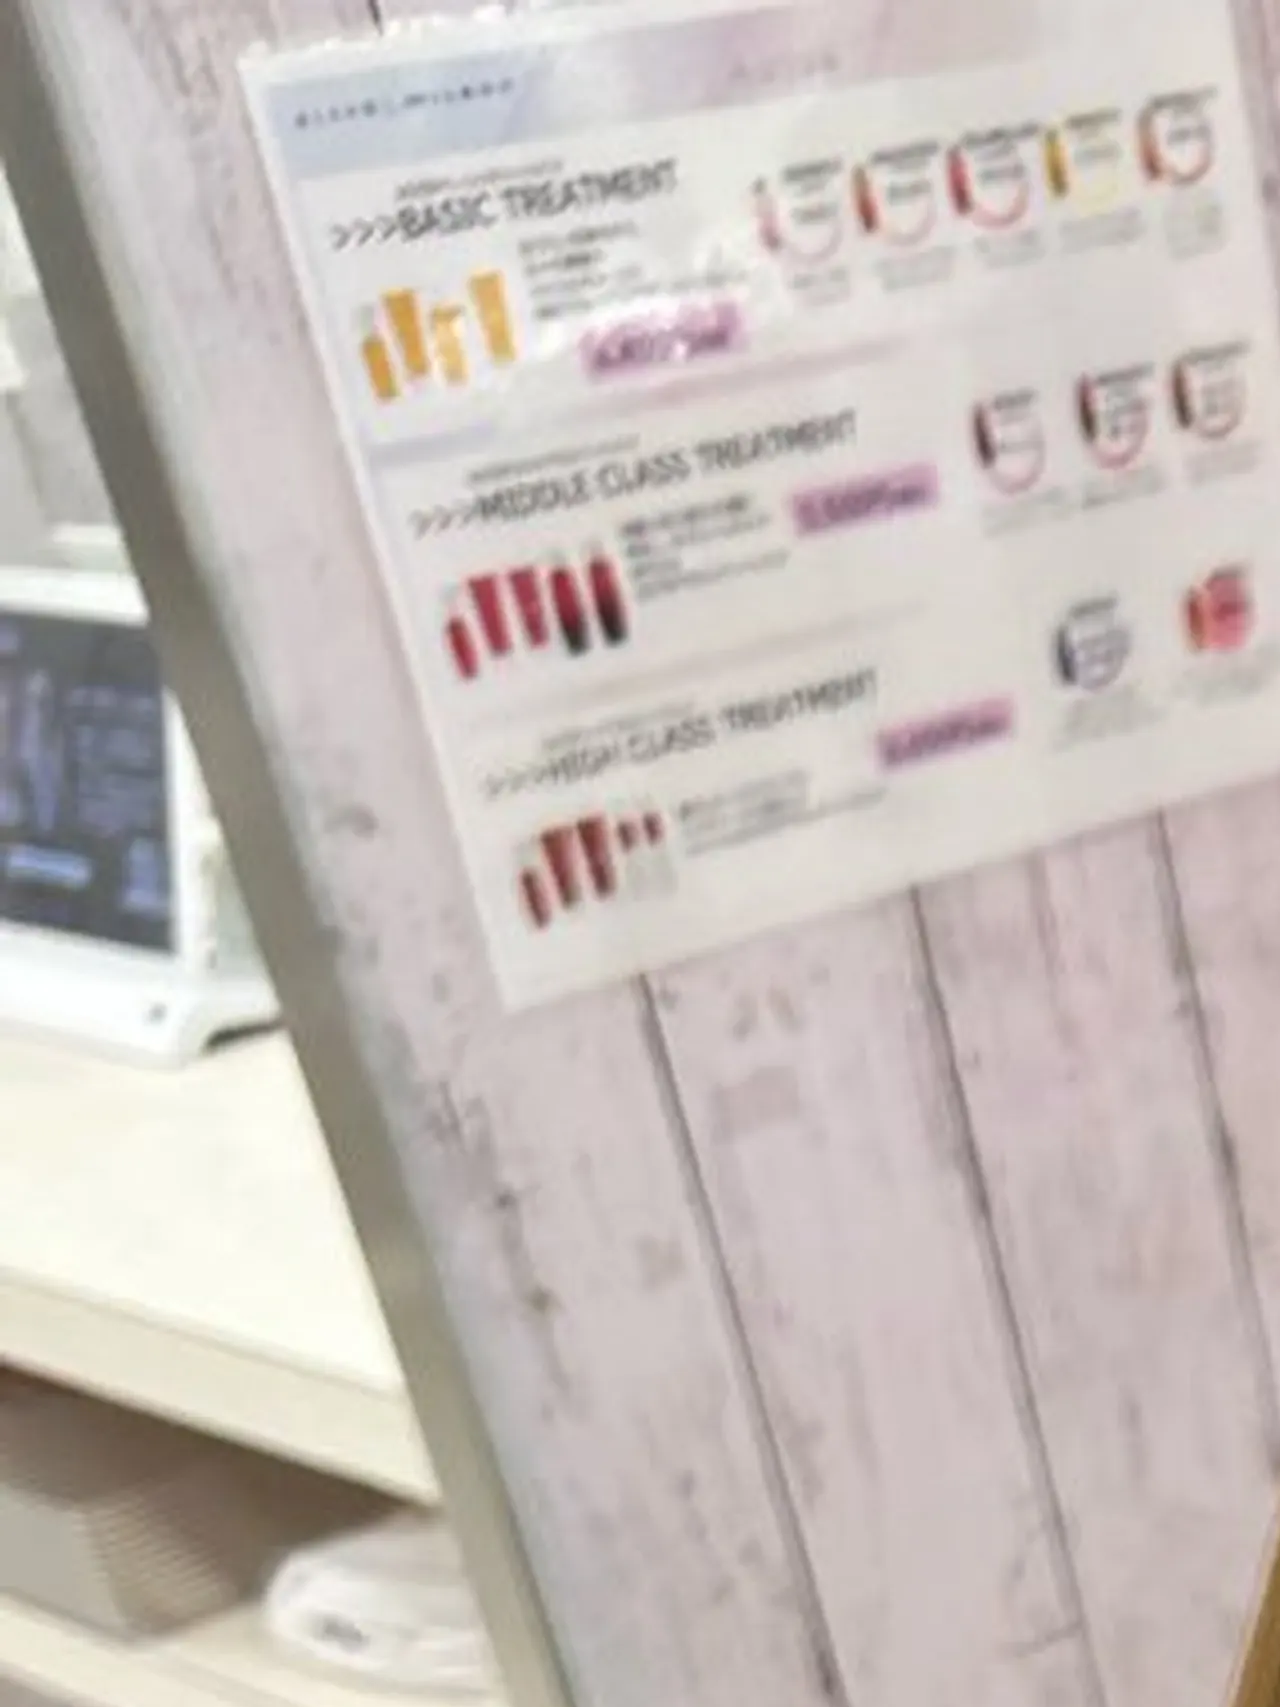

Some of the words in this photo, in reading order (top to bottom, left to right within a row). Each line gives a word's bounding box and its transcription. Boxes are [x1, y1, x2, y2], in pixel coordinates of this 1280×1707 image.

[503, 159, 677, 218] TREATMENT
[598, 448, 693, 500] CLASS
[696, 408, 856, 470] TREATMENT
[626, 712, 717, 766] CLASS
[720, 667, 878, 731] TREATMENT
